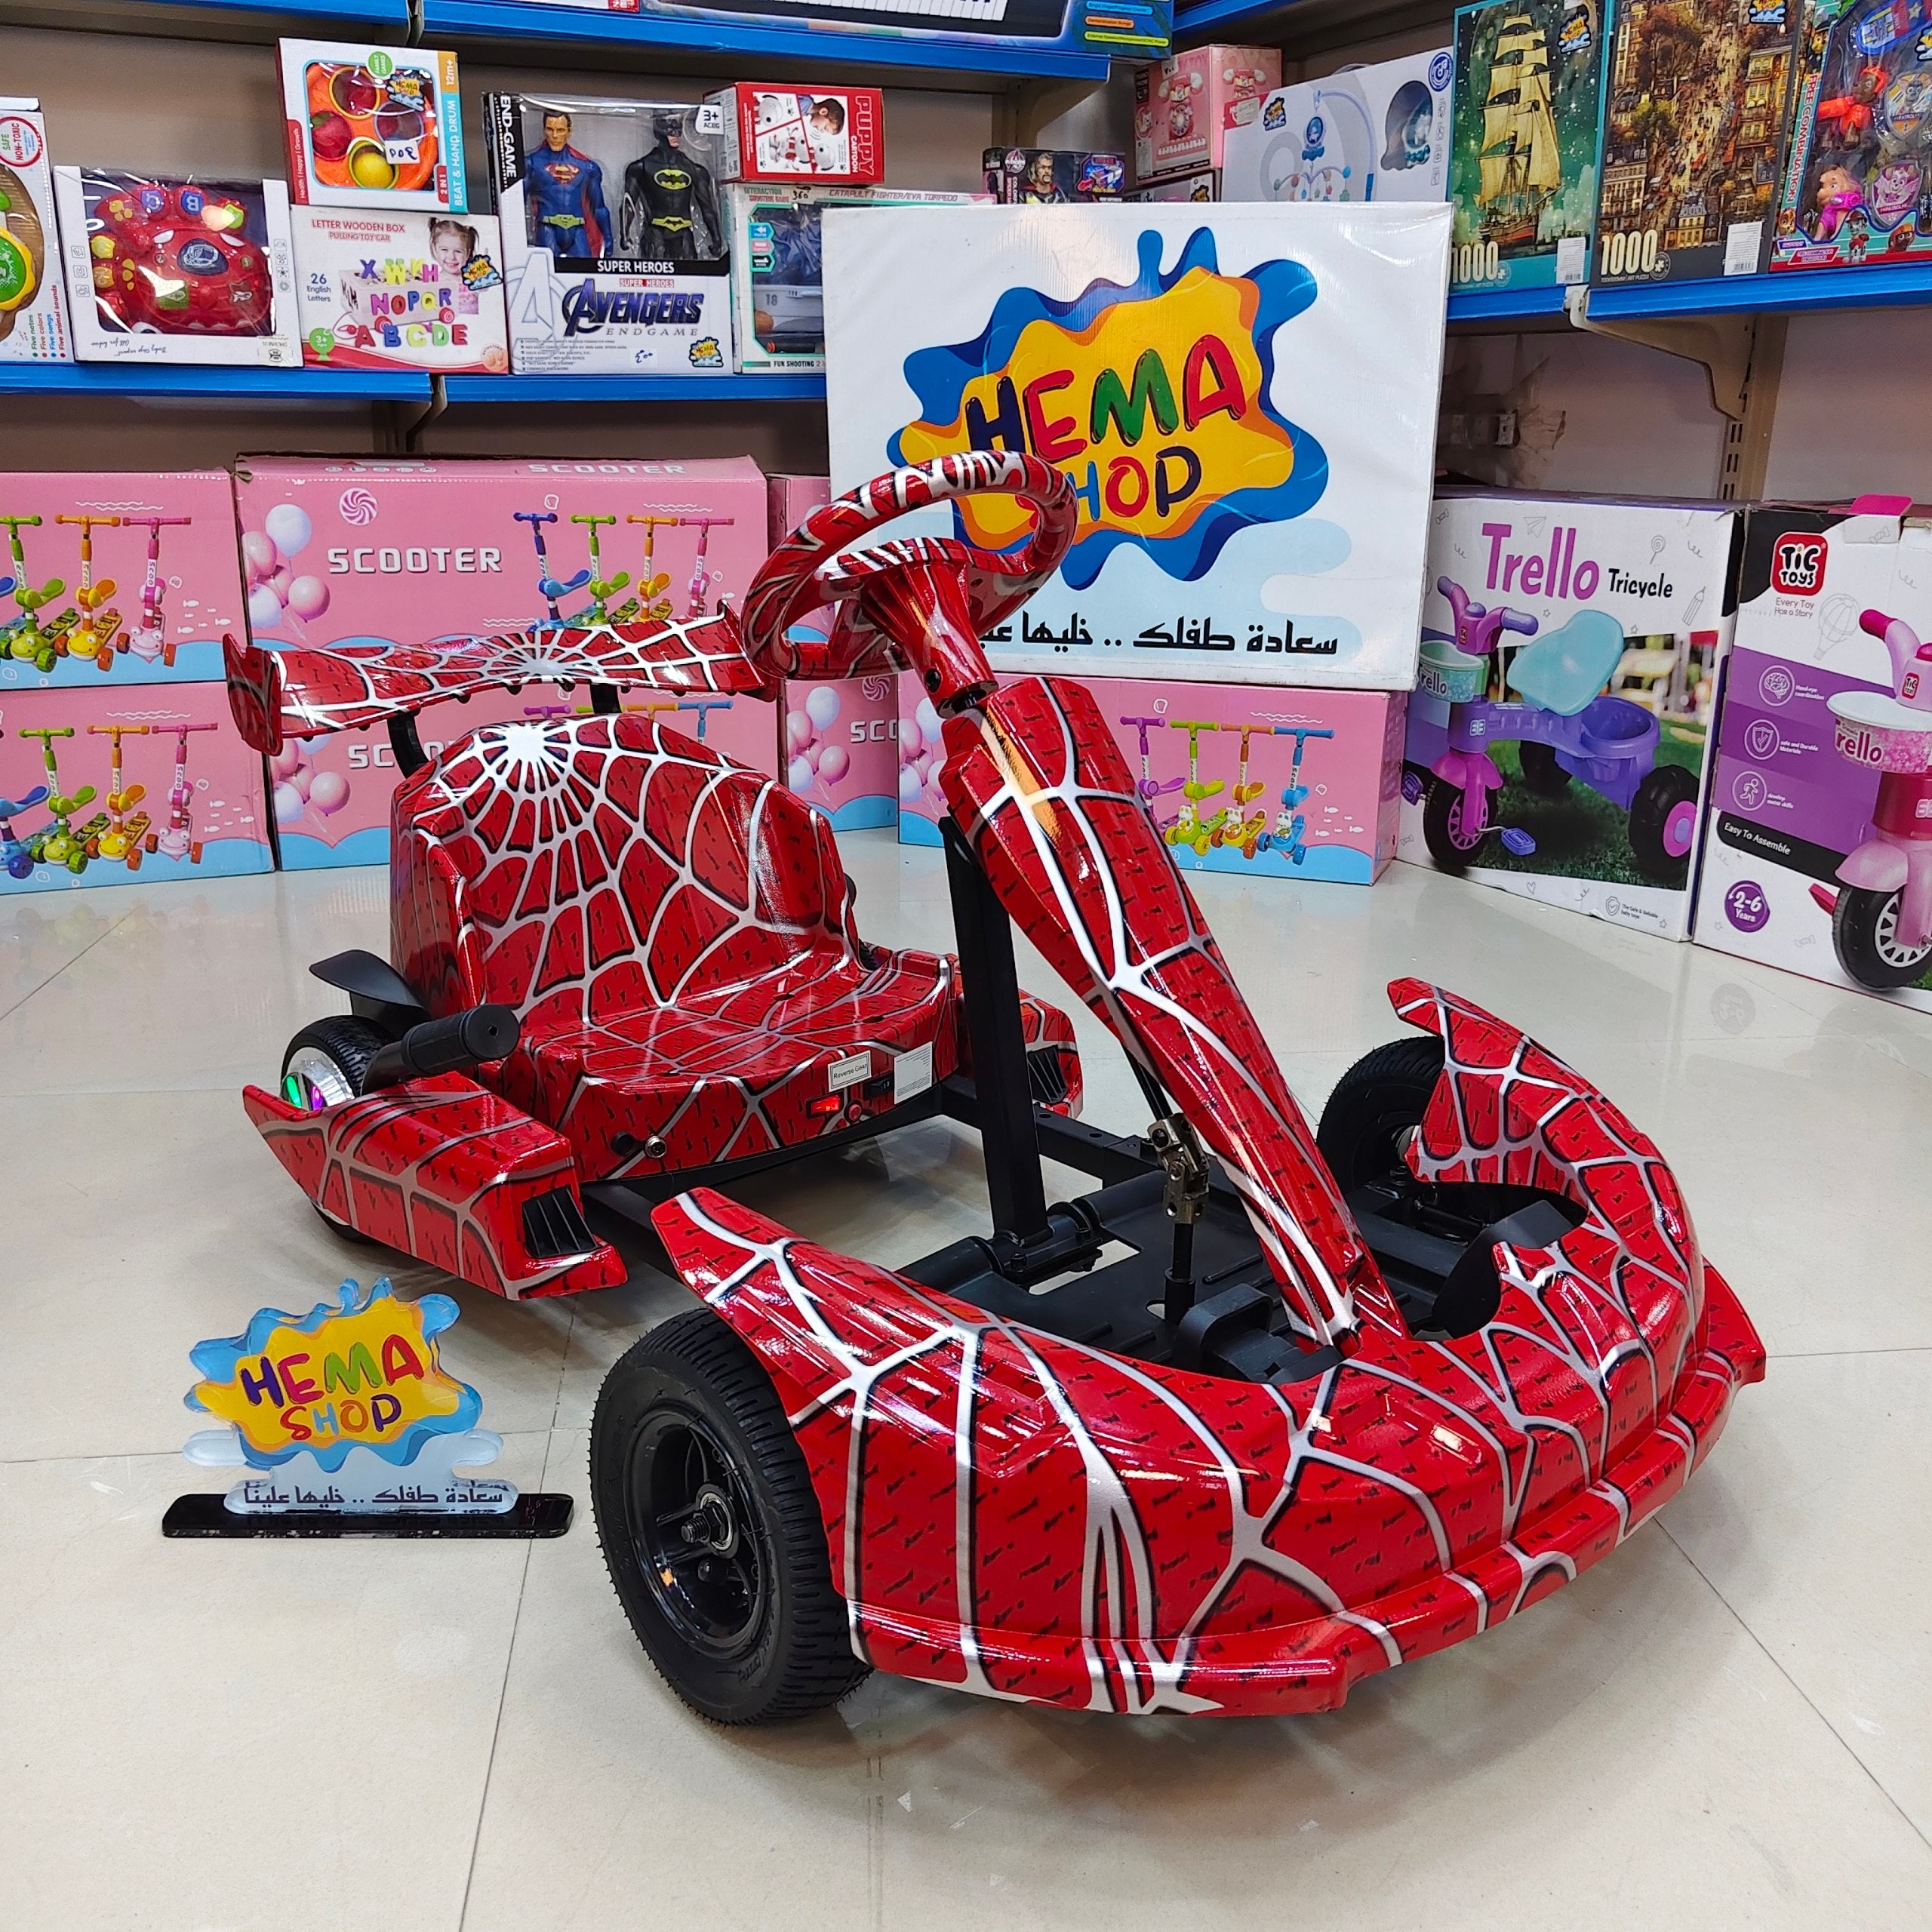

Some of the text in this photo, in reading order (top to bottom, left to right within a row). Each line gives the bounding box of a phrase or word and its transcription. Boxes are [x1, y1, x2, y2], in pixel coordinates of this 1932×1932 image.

[447, 100, 458, 133] DRUM
[703, 109, 719, 122] 3+
[2, 134, 11, 151] SAFE
[11, 122, 23, 161] NON-TOXIC
[501, 96, 517, 178] END-GAME
[855, 95, 875, 176] PUPPY
[1786, 74, 1818, 203] FREE COMBINATION
[450, 135, 460, 167] HAND
[850, 134, 858, 174] CARTOON
[453, 181, 463, 206] BEAT
[829, 189, 869, 198] CATAPULT
[312, 219, 405, 232] LETTER WOODEN BOX
[329, 232, 358, 240] PULLING
[1452, 241, 1499, 284] 1000
[1601, 229, 1659, 276] 1000
[311, 272, 327, 285] 26
[597, 260, 675, 273] SUPER HEROES
[306, 286, 331, 294] English
[647, 279, 674, 288] HEROES
[51, 285, 60, 309] sounds
[562, 278, 705, 337] AVENGERS
[54, 312, 63, 334] animal
[606, 328, 699, 337] ENDGAME
[966, 334, 1247, 462] HEMA
[528, 463, 687, 475] SCOOTER
[1015, 445, 1201, 528] HOP
[327, 547, 502, 574] SCOOTER
[1481, 522, 1673, 601] Trello Tricycle
[1774, 607, 1787, 616] Has
[1795, 608, 1813, 619] Story
[1776, 597, 1814, 611] Every Toy
[1022, 610, 1094, 653] خليها
[1133, 616, 1235, 653] طفلك
[1247, 620, 1338, 655] سعادة
[1835, 719, 1882, 763] rello
[1724, 822, 1791, 855] Easy To Assemble
[1733, 891, 1762, 912] 2-6
[1735, 909, 1756, 923] Years
[833, 1063, 868, 1080] Reverse Gear
[239, 1334, 426, 1408] HEMA
[281, 1393, 401, 1441] SHOP
[245, 1484, 291, 1505] علينا
[297, 1485, 345, 1505] خليها
[372, 1484, 438, 1504] طفلك
[445, 1486, 503, 1505] سعادة
